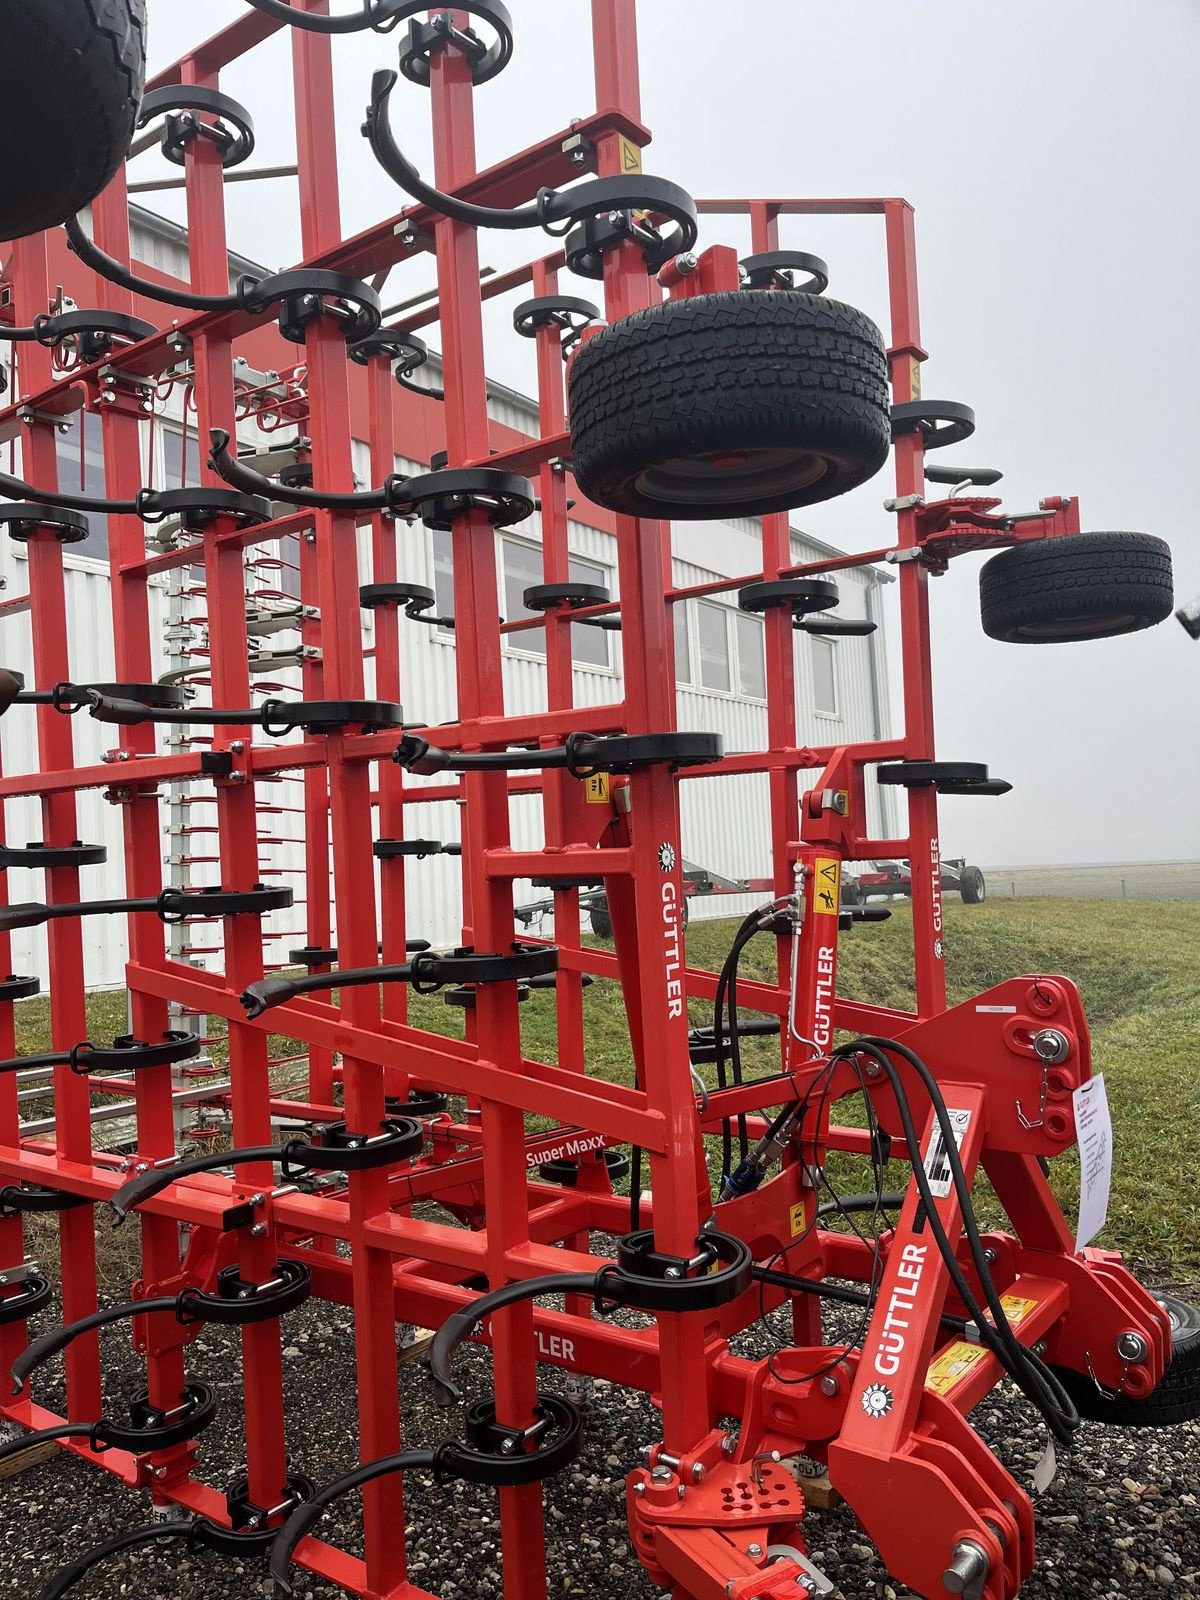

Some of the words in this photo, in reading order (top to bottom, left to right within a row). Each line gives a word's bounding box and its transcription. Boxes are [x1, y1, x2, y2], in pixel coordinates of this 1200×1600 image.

[662, 882, 682, 1020] GÜTTLER
[813, 946, 834, 1046] GÜTTLER
[526, 1145, 564, 1167] Super
[565, 1135, 606, 1156] Maxx
[875, 1243, 928, 1376] GÜTTLER
